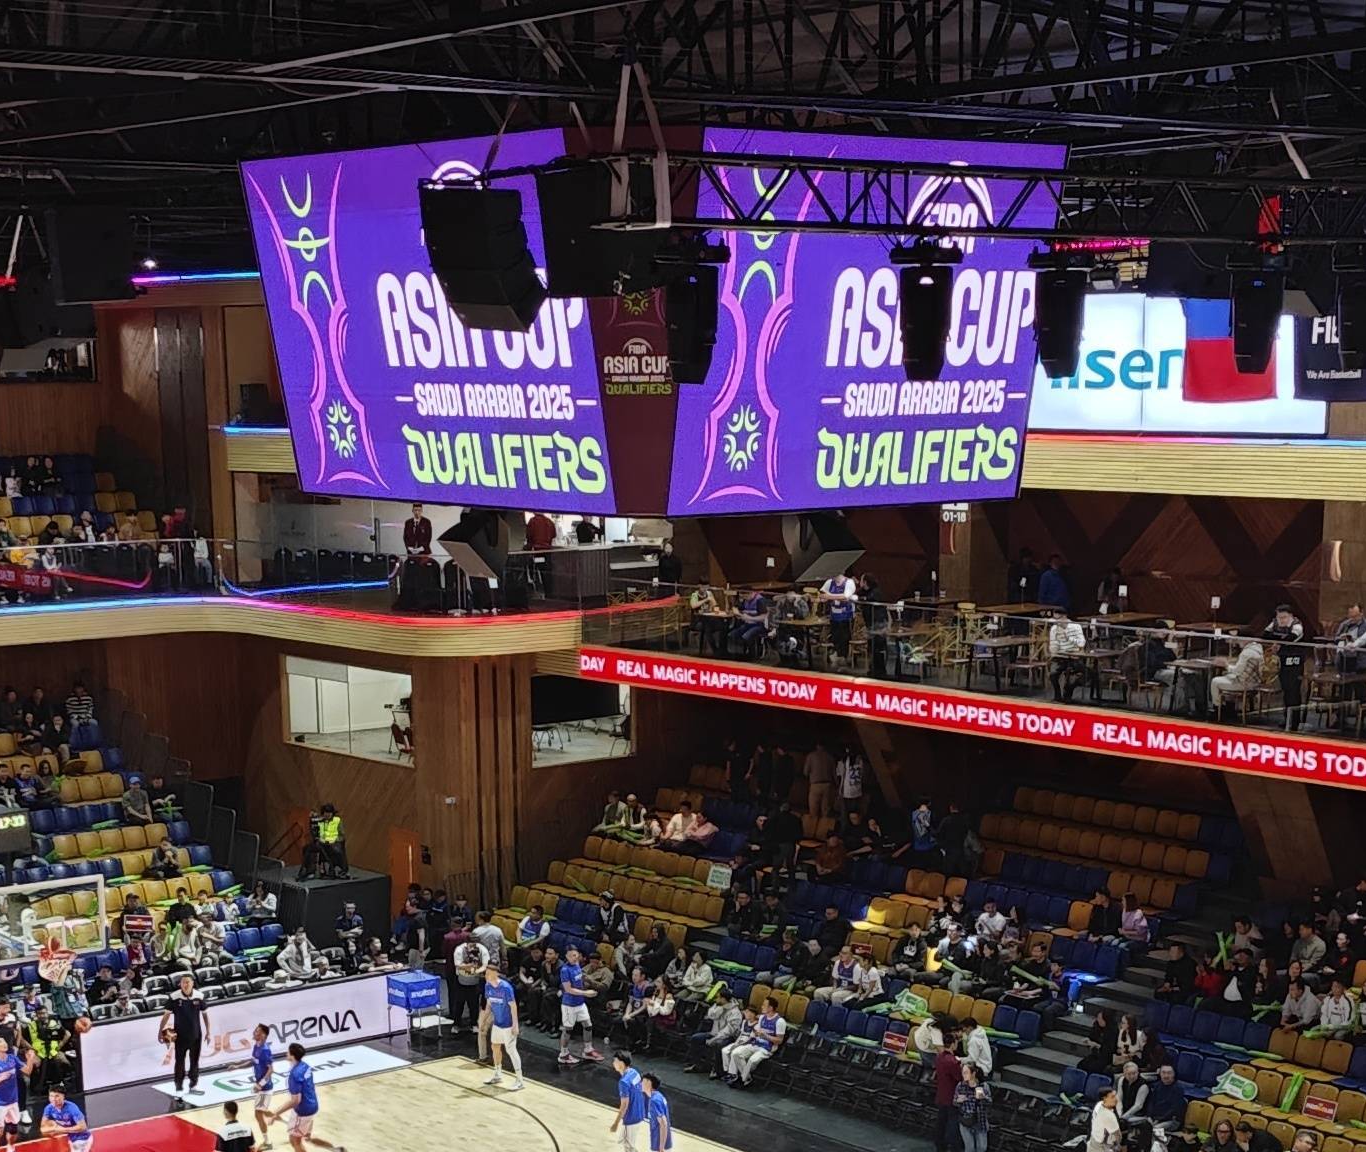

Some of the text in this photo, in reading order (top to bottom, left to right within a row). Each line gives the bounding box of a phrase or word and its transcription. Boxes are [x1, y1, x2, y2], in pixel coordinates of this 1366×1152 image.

[946, 268, 1036, 367] CUP
[603, 355, 639, 374] ASIA
[628, 344, 647, 355] FIBA
[414, 382, 575, 420] SAUDI ARABIA 2025
[604, 383, 672, 395] QUALIFIERS
[844, 379, 1007, 418] SAUDI ARABIA 2025
[401, 424, 606, 494] QUALIFIERS
[816, 423, 1018, 489] QUALIFIERS
[580, 655, 606, 672] DAY
[617, 660, 650, 679] REAL
[654, 665, 697, 685] MAGIC
[700, 672, 765, 695] HAPPENS
[769, 680, 818, 701] TODAY
[832, 688, 871, 709] REAL
[876, 694, 928, 717] MAGIC
[933, 702, 1013, 729] HAPPENS
[1017, 713, 1075, 738] TODAY
[1093, 723, 1142, 747] REAL
[1148, 730, 1212, 757] MAGIC
[1218, 740, 1318, 771] HAPPENS
